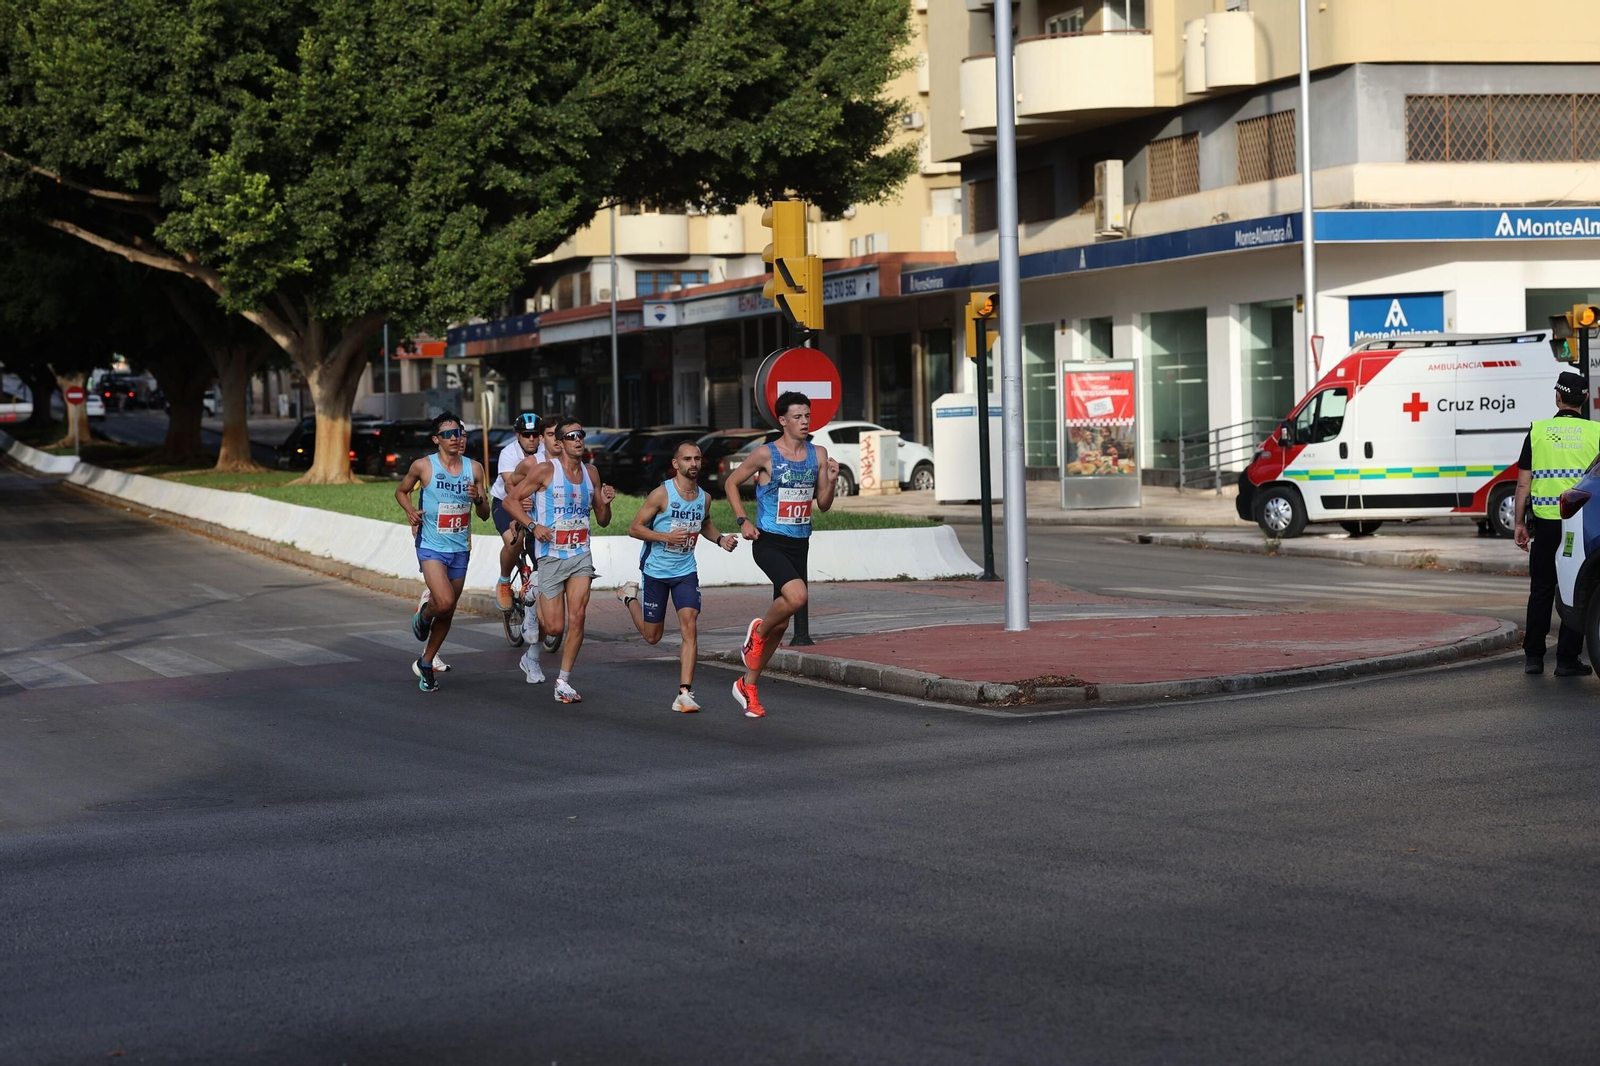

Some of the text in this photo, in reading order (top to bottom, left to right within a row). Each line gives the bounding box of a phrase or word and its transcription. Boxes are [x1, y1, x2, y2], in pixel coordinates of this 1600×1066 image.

[1235, 226, 1285, 246] MonteAlminara
[1428, 361, 1482, 371] AMBULANCIA
[1437, 394, 1516, 413] Cruz Roja
[436, 480, 468, 494] nerja
[671, 509, 701, 521] nerja
[786, 504, 808, 517] 107
[449, 517, 462, 528] 18
[567, 532, 580, 543] 15
